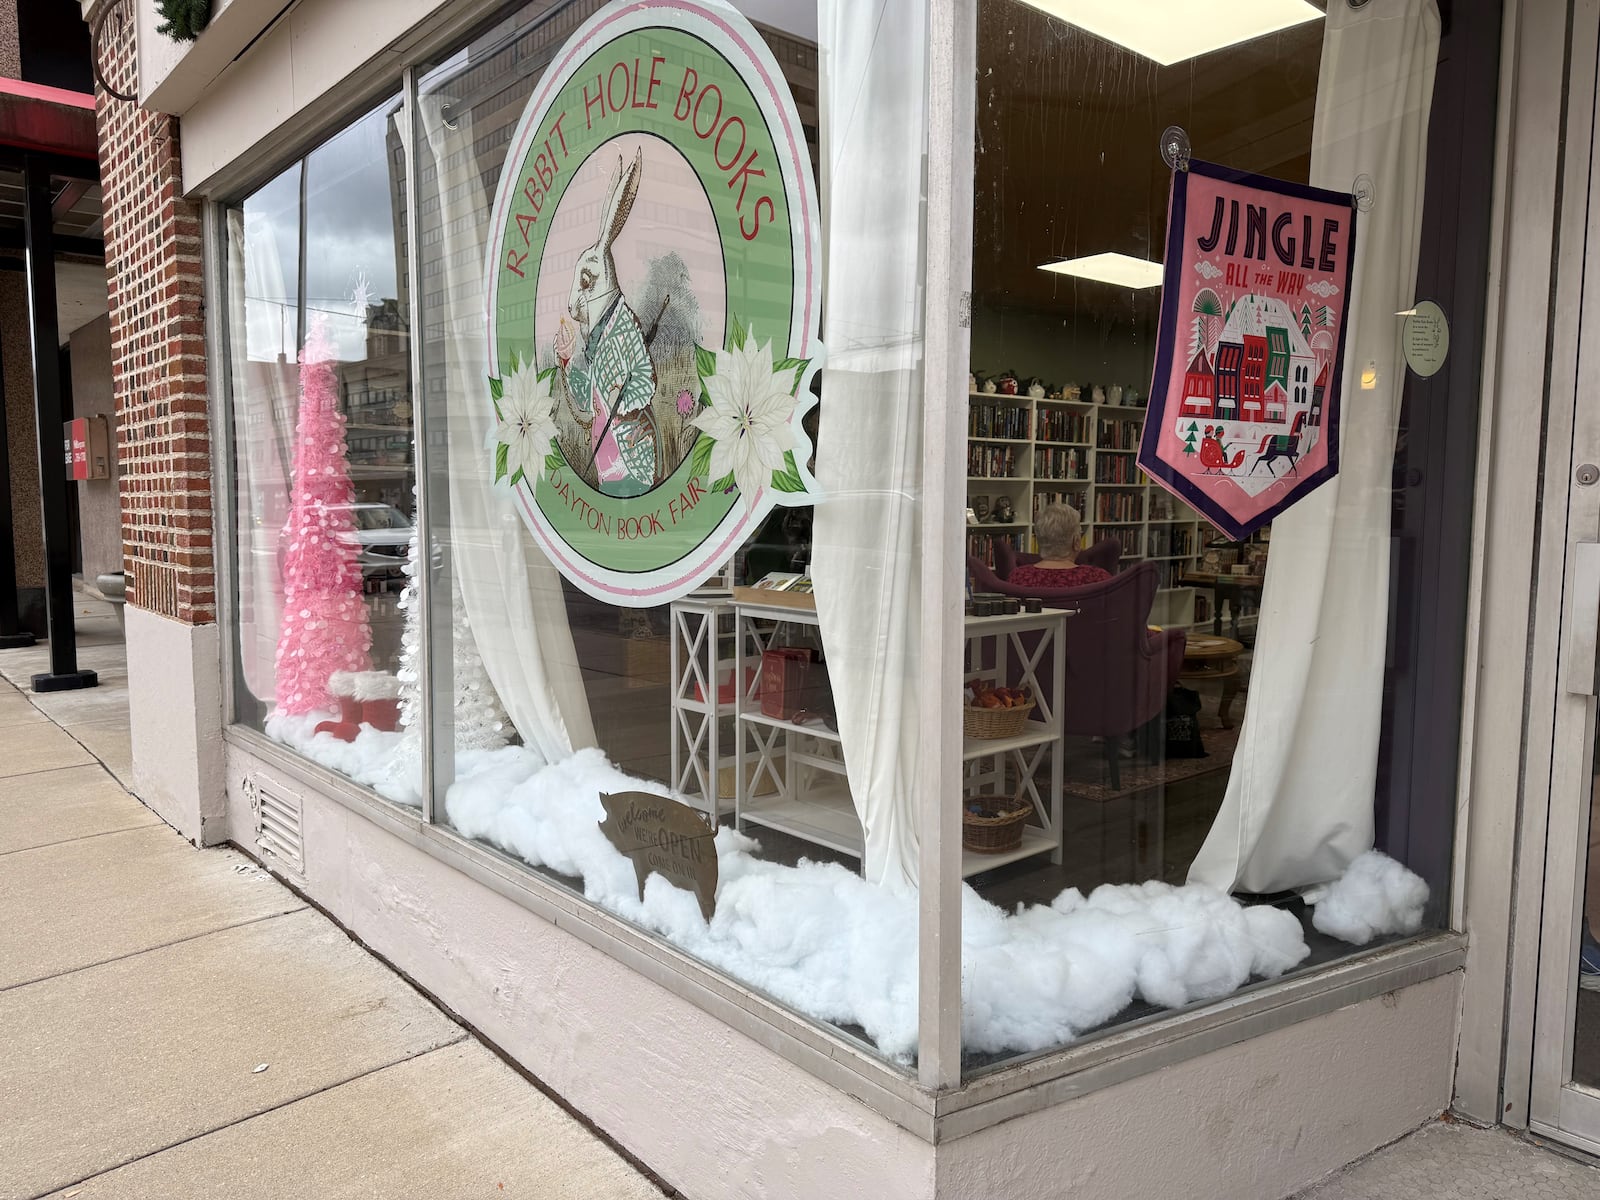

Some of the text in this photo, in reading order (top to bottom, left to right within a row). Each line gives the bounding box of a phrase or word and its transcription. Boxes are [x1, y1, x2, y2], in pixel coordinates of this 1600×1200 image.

[506, 57, 775, 278] RABBIT HOLE BOOKS
[1197, 196, 1339, 272] JINGLE
[1225, 262, 1305, 296] ALL THE WAY
[550, 469, 708, 540] DAYTON BOOK FAIR
[659, 827, 702, 864] OPEN
